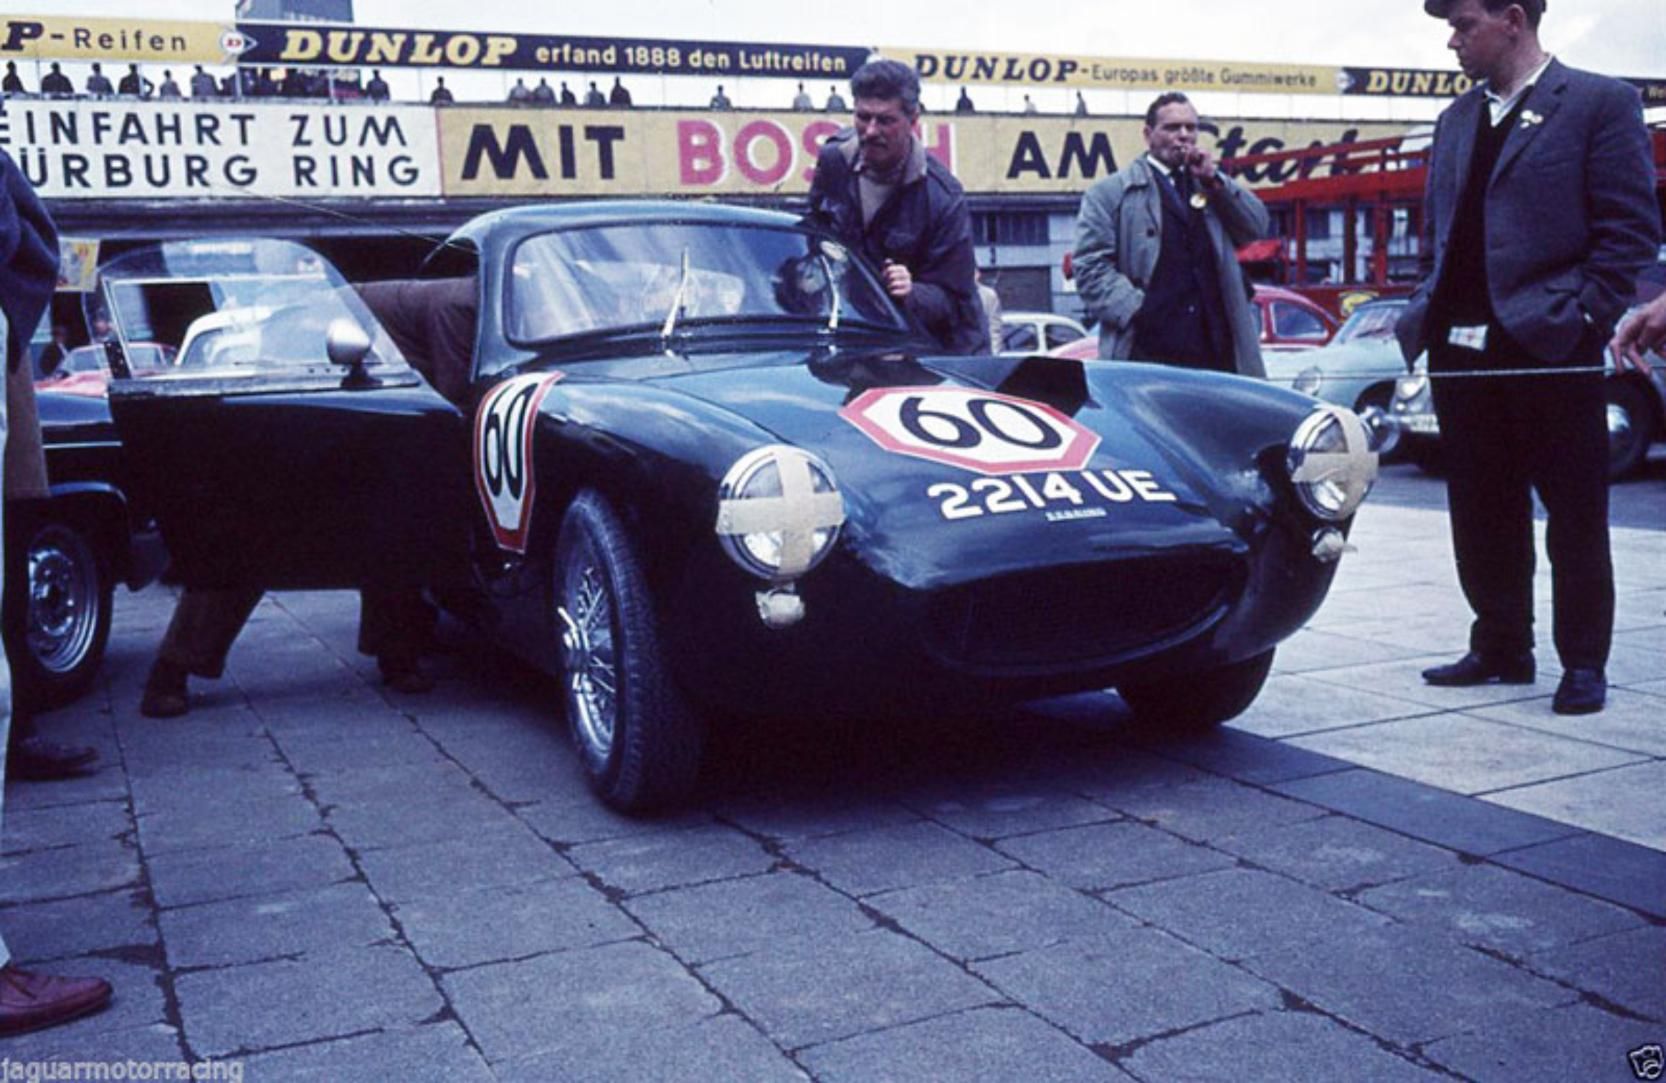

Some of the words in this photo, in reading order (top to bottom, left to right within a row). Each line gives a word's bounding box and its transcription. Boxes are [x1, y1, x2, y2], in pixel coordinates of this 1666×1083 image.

[280, 29, 518, 66] DUNLOP
[535, 44, 617, 65] erfand
[625, 46, 681, 67] 1888
[688, 49, 731, 69] den
[738, 50, 847, 72] Luftreifen
[1220, 67, 1317, 87] Gummiwerke
[1365, 70, 1473, 95] DUNLO
[290, 114, 407, 147] ZUM
[461, 124, 625, 180] MIT
[1006, 131, 1118, 180] AM
[19, 147, 258, 188] ÜRBURG
[292, 155, 419, 187] RING
[484, 382, 539, 501] 60
[900, 396, 1062, 450] 60
[927, 472, 1083, 519] 2214
[1081, 470, 1177, 502] UE
